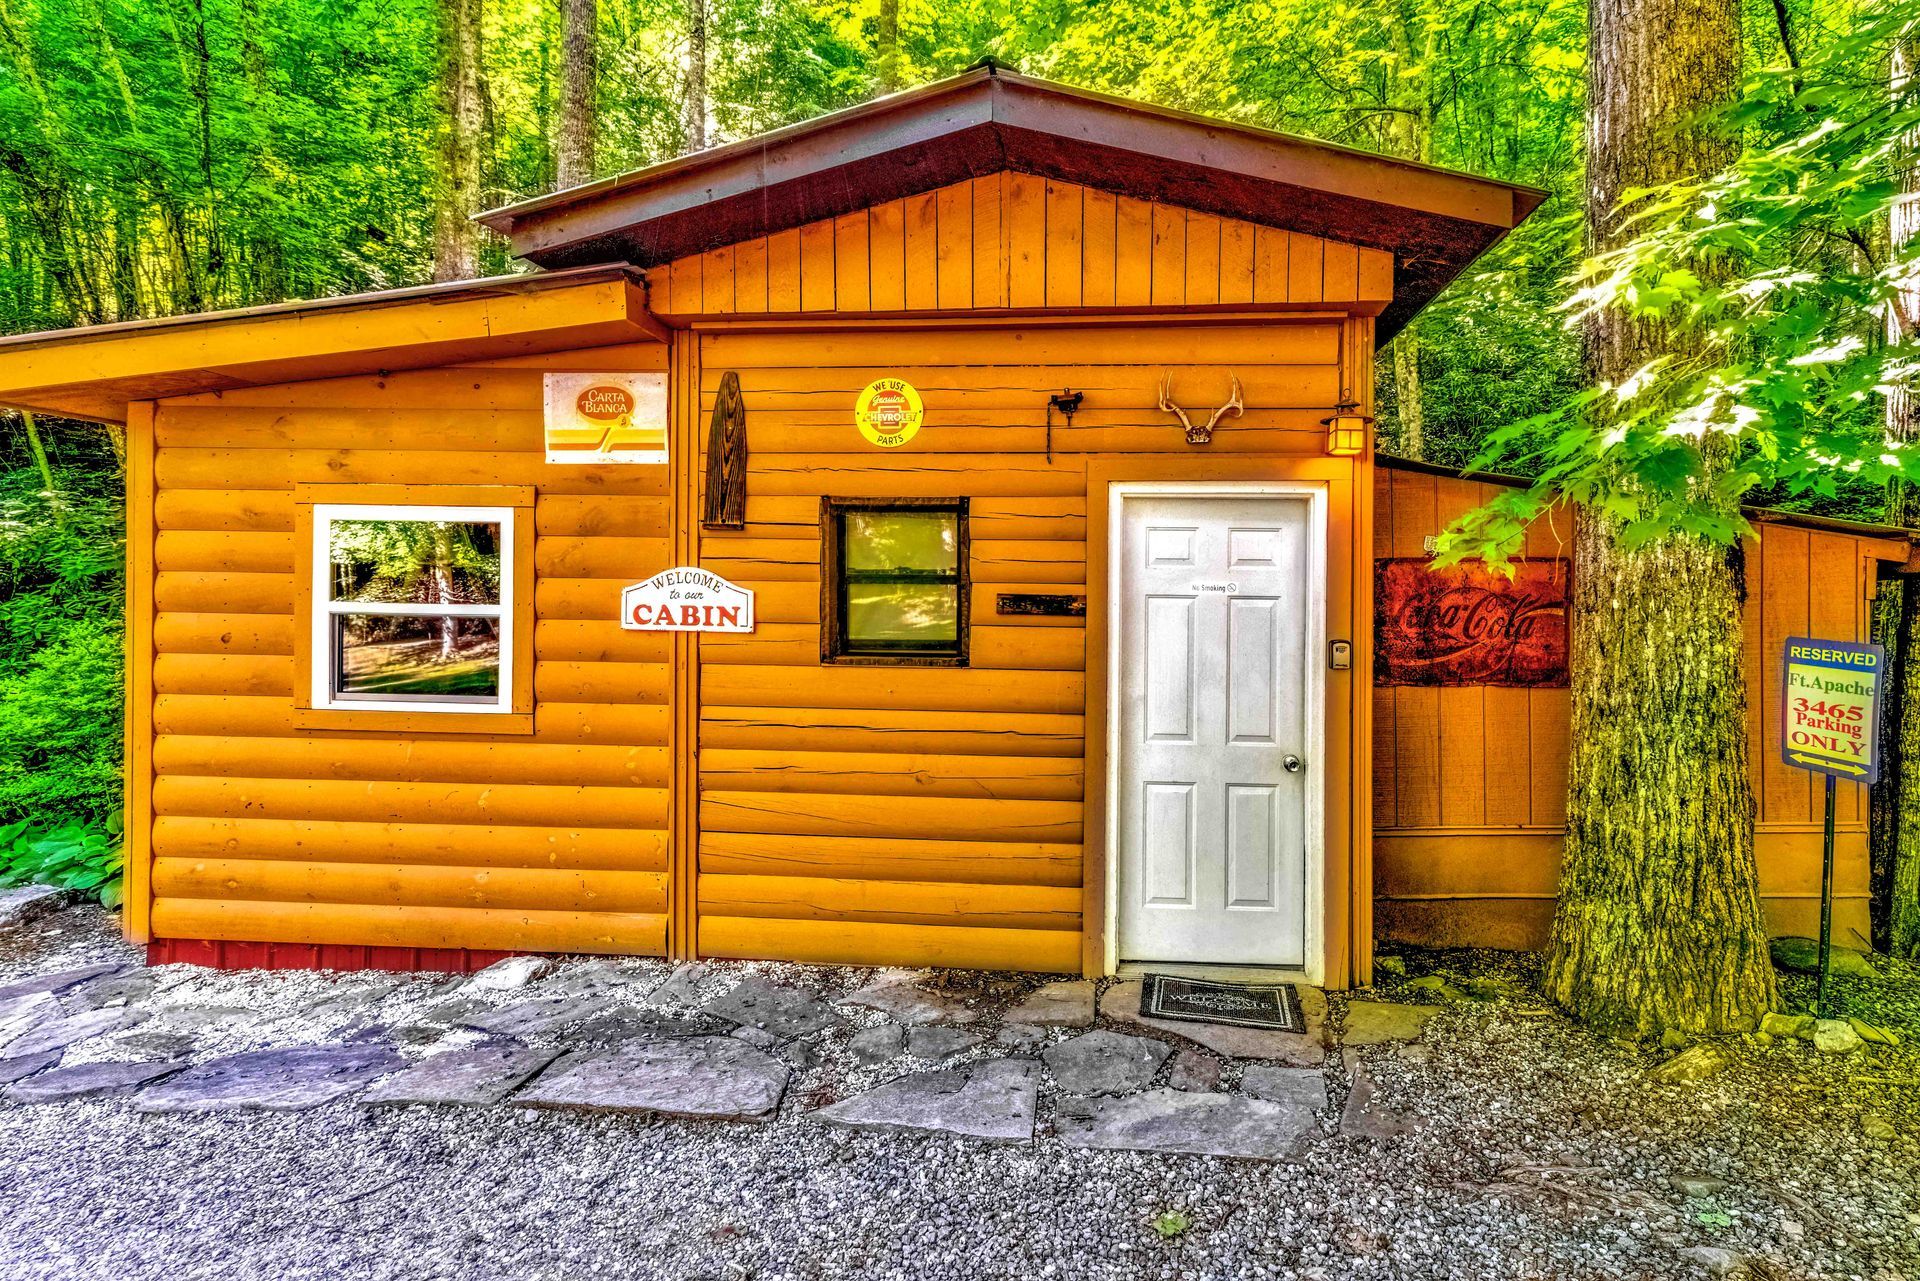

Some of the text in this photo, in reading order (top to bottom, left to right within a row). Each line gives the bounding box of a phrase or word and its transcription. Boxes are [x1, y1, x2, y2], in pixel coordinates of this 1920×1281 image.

[872, 380, 905, 392] WE USE
[588, 390, 625, 402] CARTA
[582, 401, 627, 413] BLANCA
[863, 412, 917, 422] CHEVROLET
[877, 434, 904, 445] PARTS
[651, 571, 723, 593] WELCOME
[669, 588, 704, 600] to our
[1201, 584, 1226, 593] Smoking
[633, 604, 741, 627] CABIN
[1790, 645, 1877, 667] RESERVED
[1793, 697, 1864, 721] 3465
[1796, 712, 1863, 739] Parking
[1791, 731, 1867, 757] ONLY
